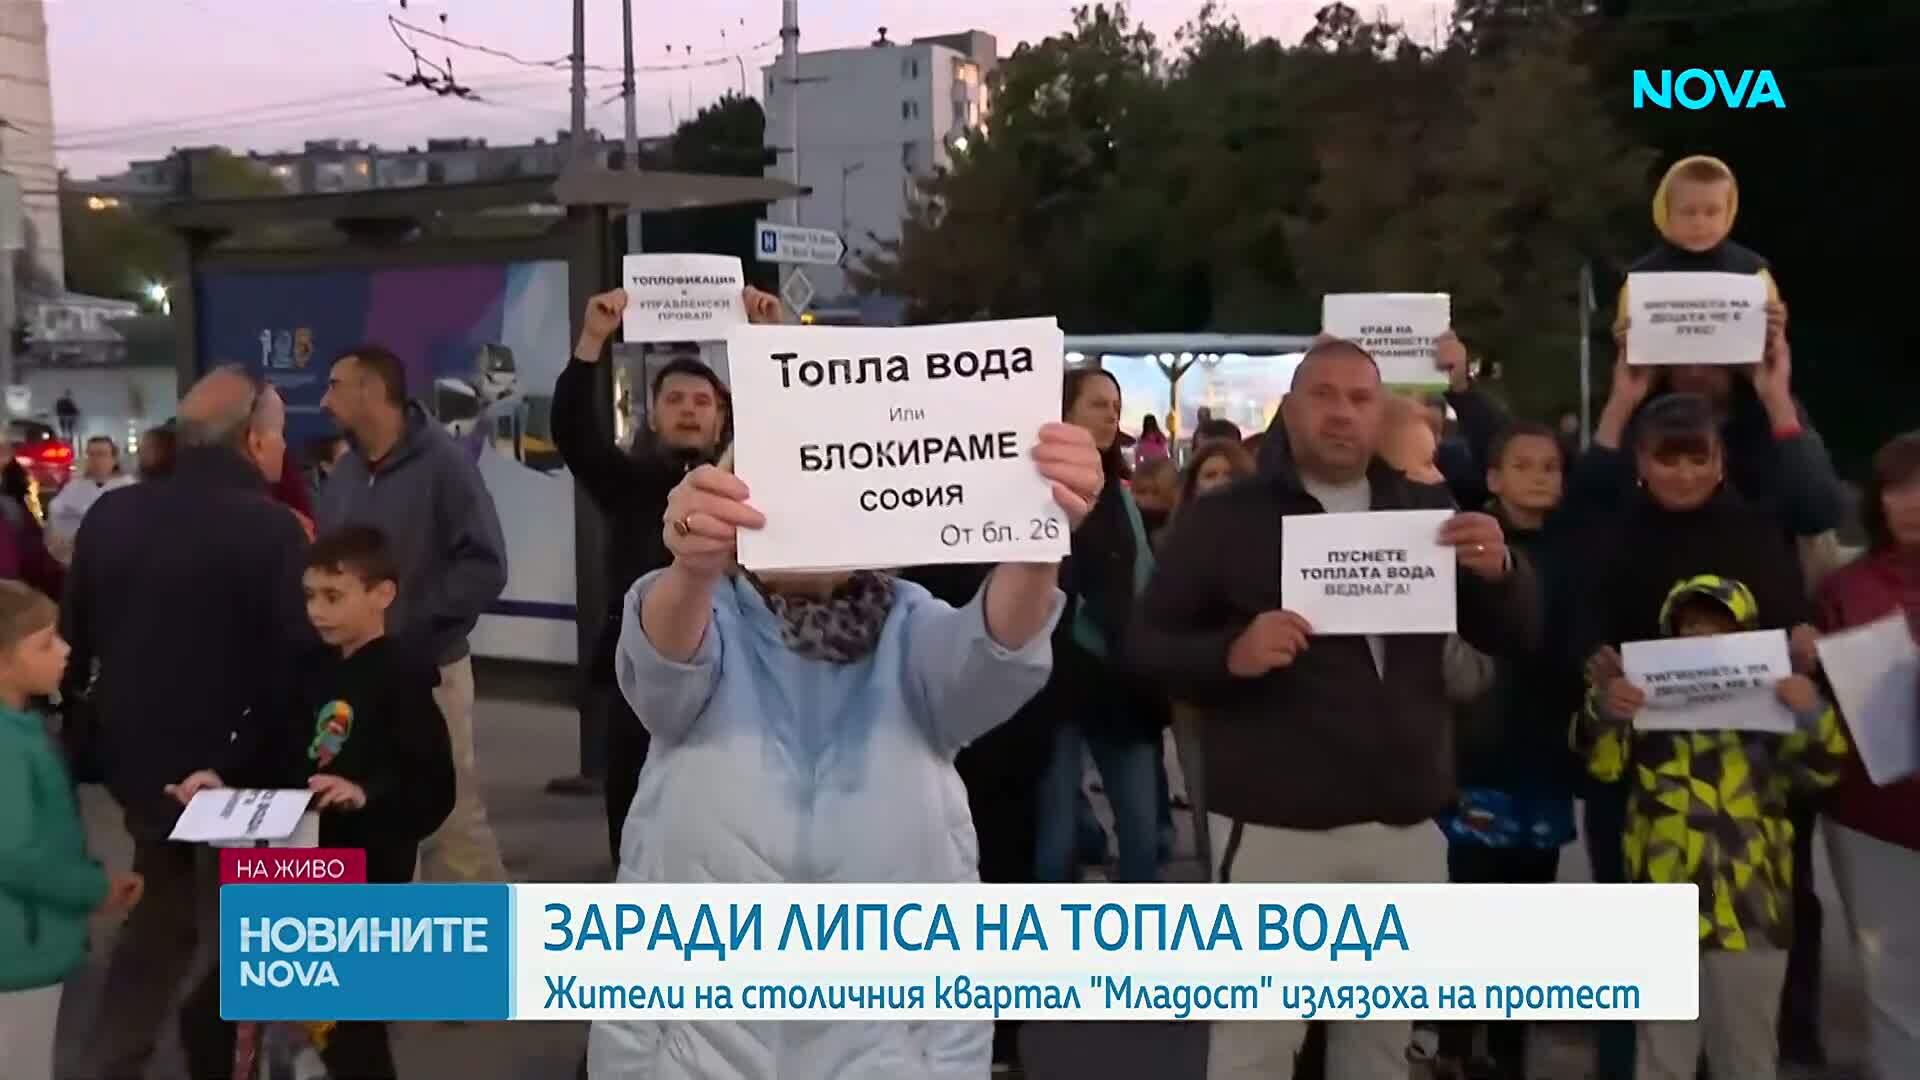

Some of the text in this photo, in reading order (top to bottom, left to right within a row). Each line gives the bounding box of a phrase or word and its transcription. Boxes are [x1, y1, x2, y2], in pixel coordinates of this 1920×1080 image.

[632, 274, 737, 286] ТОПЛОФИКАЦИЯ
[770, 346, 1034, 388] Топла вода
[889, 406, 926, 422] Или
[800, 431, 1019, 472] БЛОКИРАМЕ
[859, 484, 964, 511] СОФИЯ
[940, 518, 1060, 547] От бл. 26
[1327, 549, 1408, 563] ПУСНЕТЕ
[1300, 565, 1436, 580] ТОПЛАТА ВОДА
[1324, 583, 1411, 597] ВЕДНАГА!
